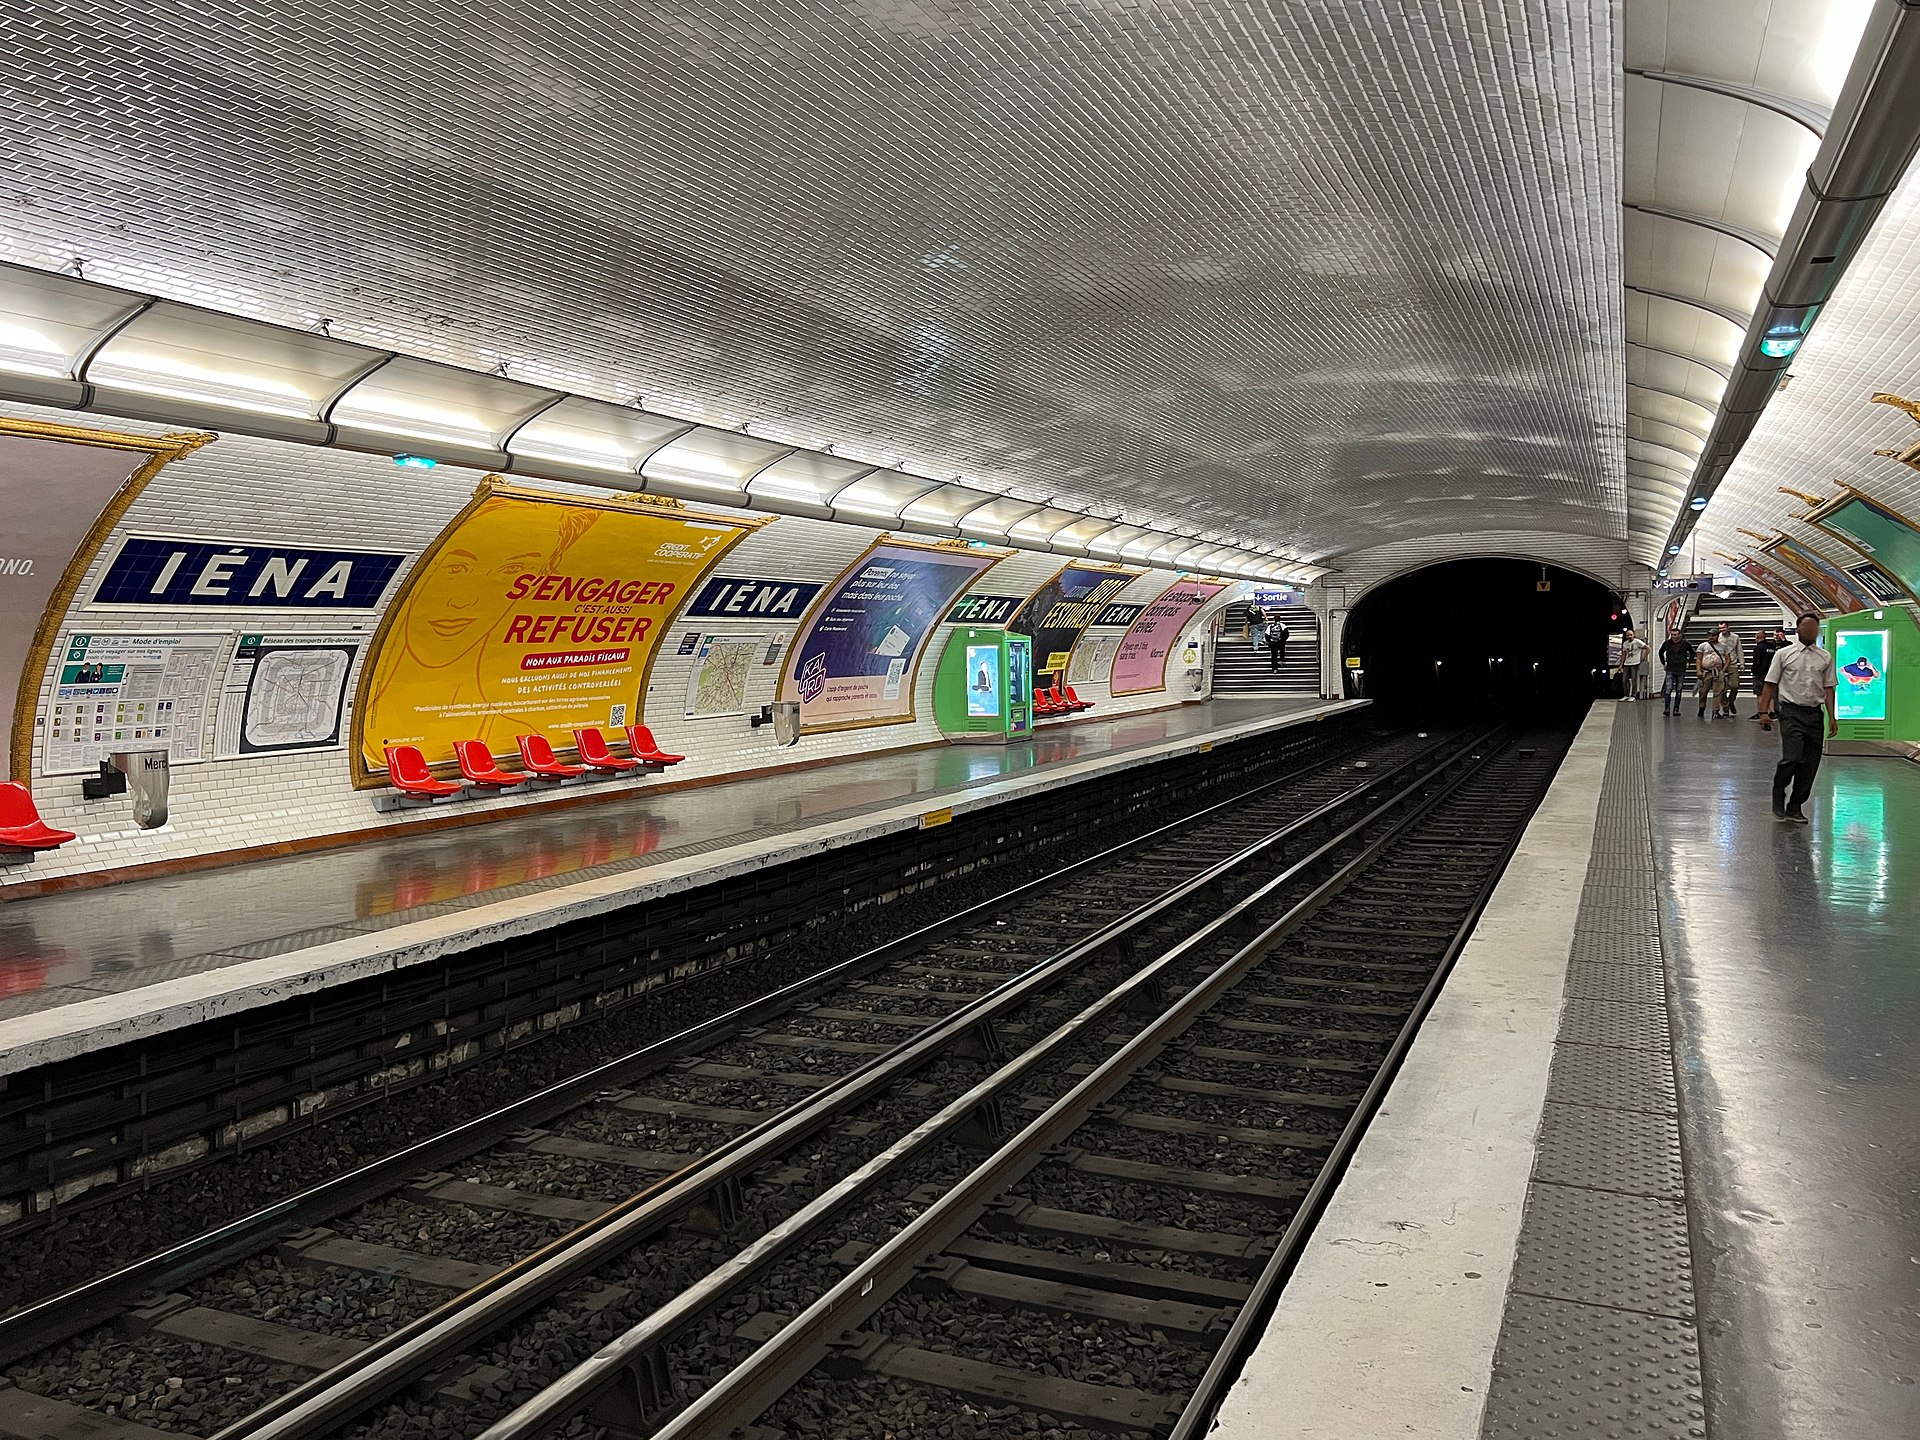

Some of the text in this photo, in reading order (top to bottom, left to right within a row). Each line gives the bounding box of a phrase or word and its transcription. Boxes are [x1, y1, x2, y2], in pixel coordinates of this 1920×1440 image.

[150, 548, 354, 599] IÉNA
[505, 573, 676, 605] S'ENGAGER
[849, 579, 866, 589] plus
[1082, 579, 1126, 604] 1001
[1663, 579, 1687, 589] Sorti
[708, 581, 799, 612] IÉNA
[841, 590, 859, 599] mais
[857, 591, 874, 600] dans
[1263, 593, 1287, 602] Sortie
[573, 604, 633, 615] C'EST AUSSI
[958, 597, 1010, 620] IÉNA
[1039, 602, 1100, 628] FESTIVALS
[1100, 604, 1137, 623] IÉNA
[503, 614, 653, 644] REFUSER
[154, 638, 181, 647] d'emploi
[295, 637, 322, 646] transports
[525, 651, 626, 667] NON AUX PARADIS FISCAUX
[501, 666, 632, 684] NOUS EXCLUONS AUSSI DE NOS FINANCEMENTS
[517, 686, 531, 694] DES
[533, 682, 567, 693] ACTIVITÉS
[144, 757, 167, 770] Merc
